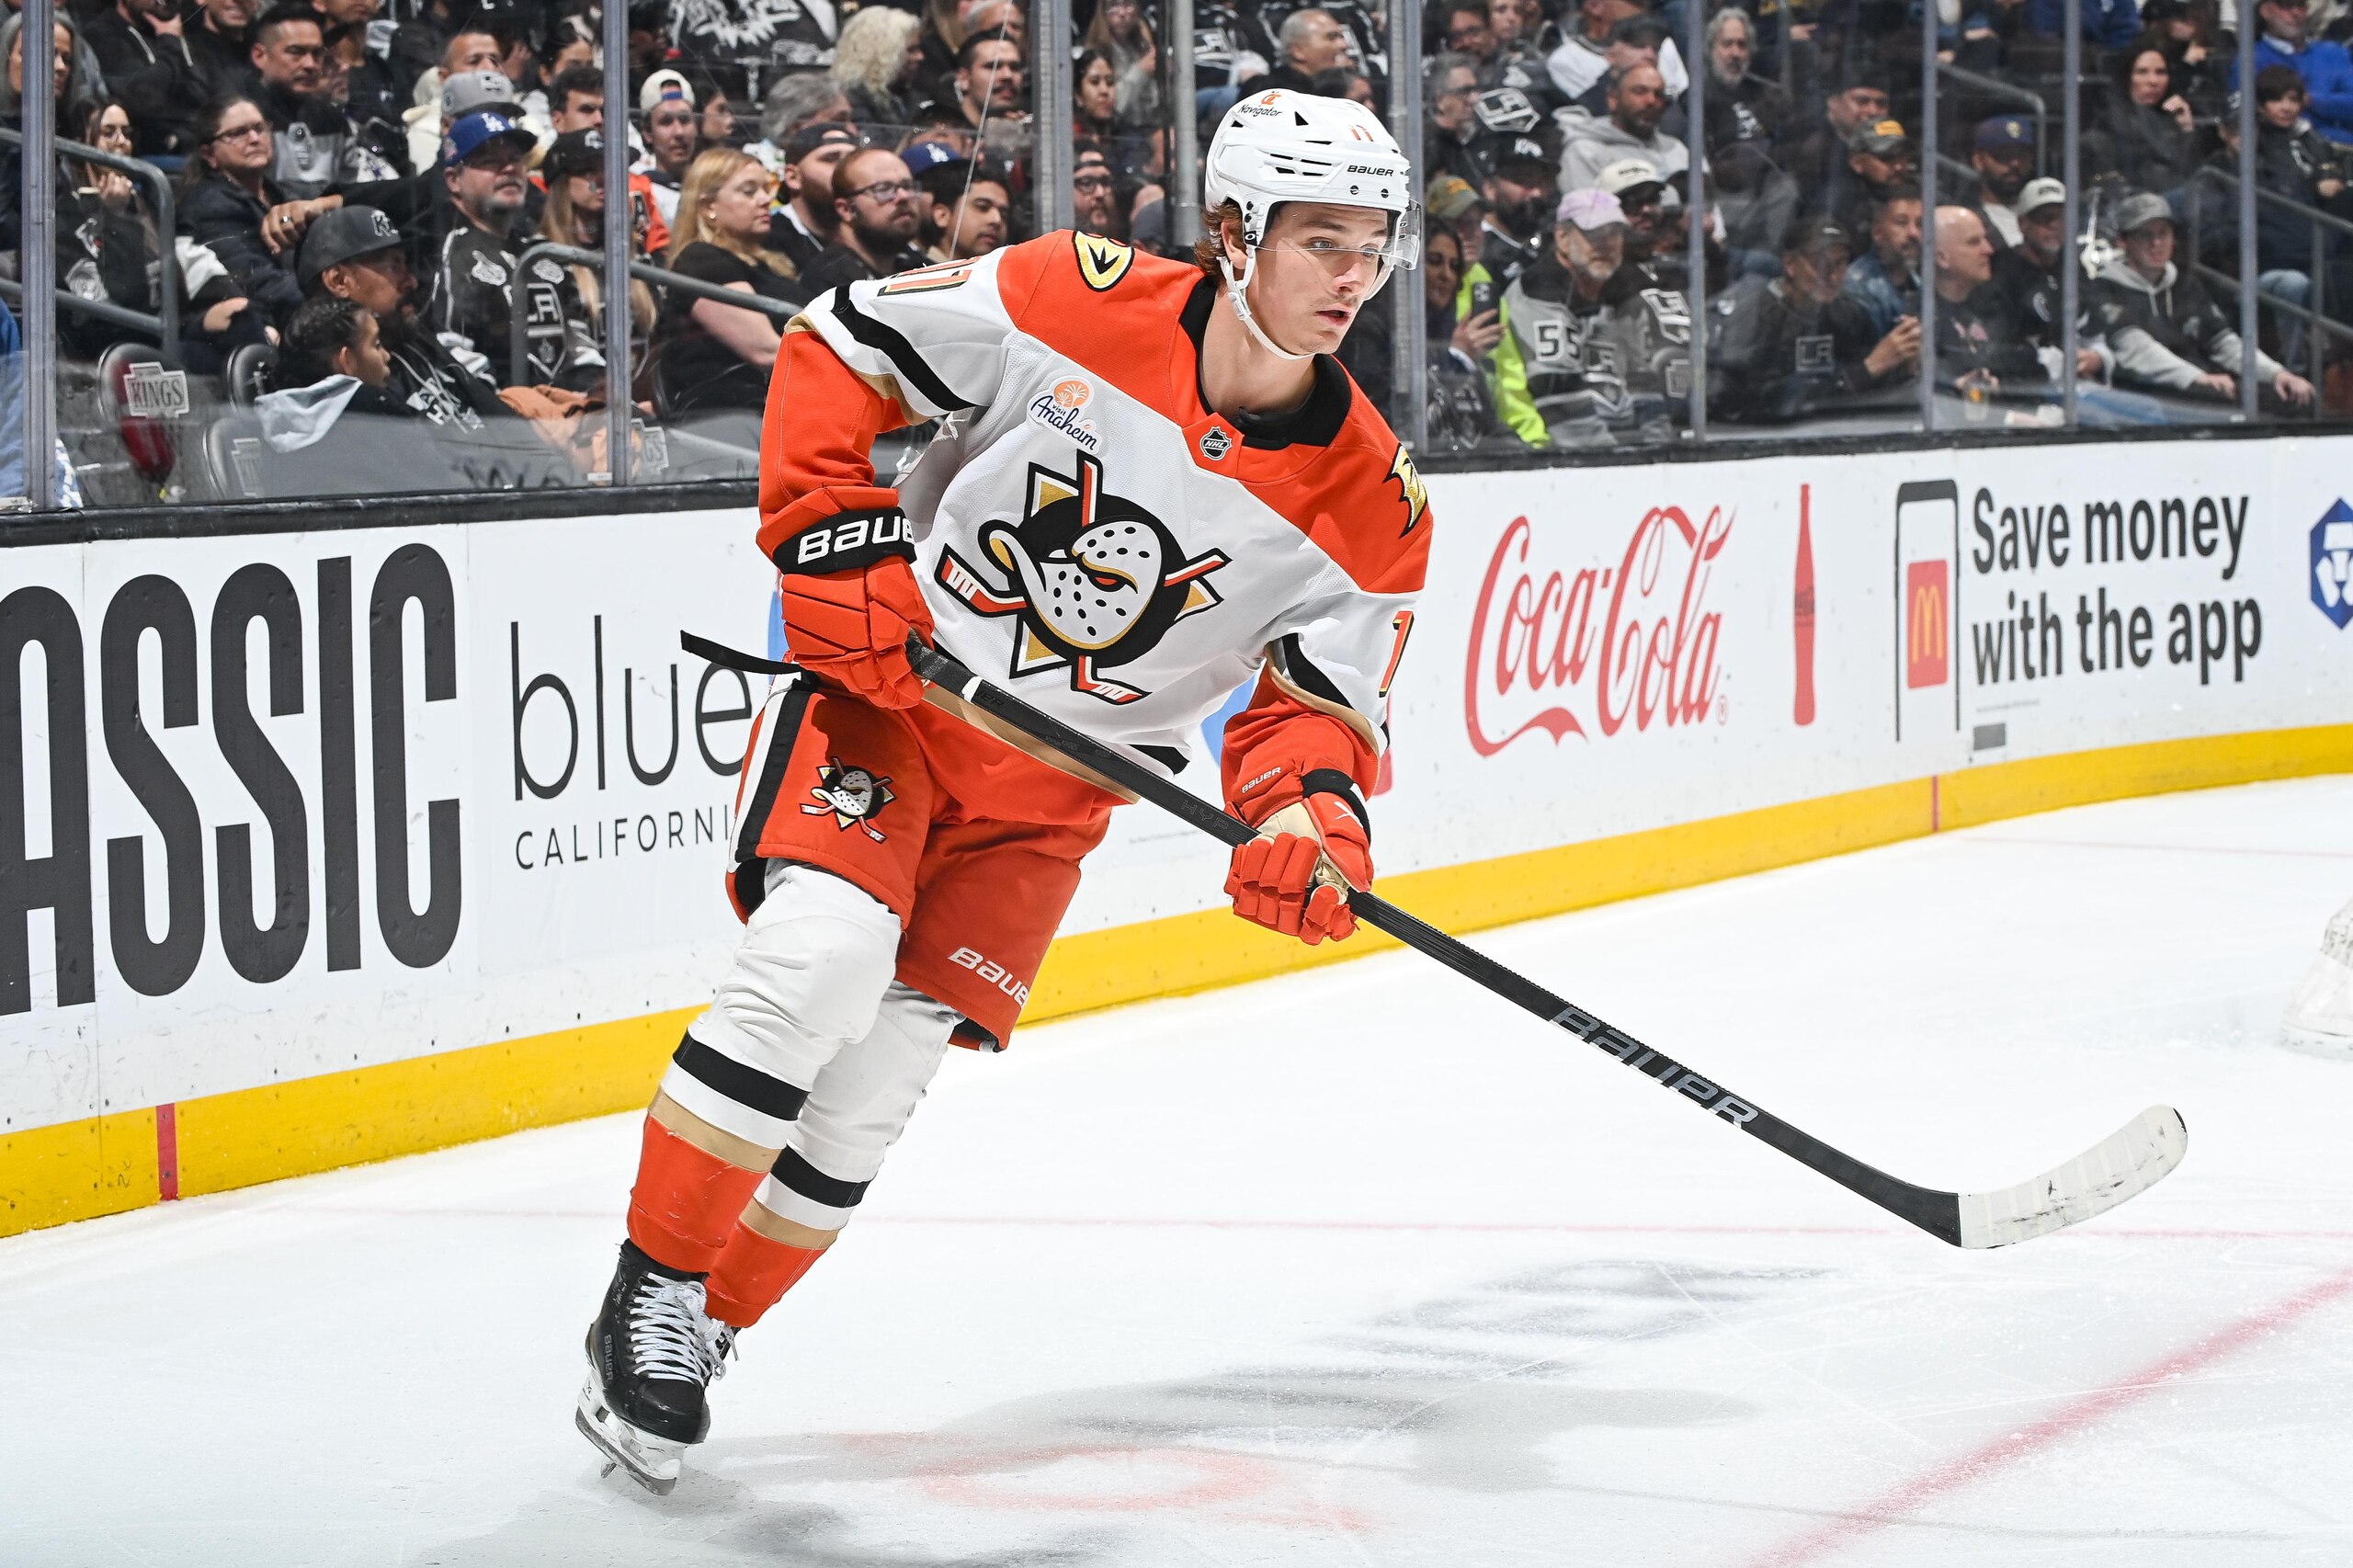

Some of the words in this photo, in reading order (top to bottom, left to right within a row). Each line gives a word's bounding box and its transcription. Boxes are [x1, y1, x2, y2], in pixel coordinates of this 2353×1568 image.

[482, 112, 506, 132] LA
[1237, 104, 1283, 117] Navigator
[1347, 165, 1394, 177] BAUER
[131, 379, 184, 408] KINGS
[1051, 404, 1067, 416] visit
[1030, 395, 1097, 450] Anaheim
[1204, 440, 1225, 449] NHL
[797, 516, 915, 564] BAUE
[1972, 487, 2070, 574] Save
[2085, 495, 2249, 581] money
[1464, 504, 1737, 757] Coca-Cola
[1972, 589, 2063, 686] with
[2076, 586, 2154, 674] the
[2167, 597, 2262, 686] app
[510, 614, 753, 801] blue
[0, 542, 461, 1015] ASSIC
[1242, 767, 1281, 794] BAUER
[516, 804, 729, 870] CALIFORNI
[947, 947, 1030, 1010] BAUE
[1548, 1006, 1759, 1130] BAUER
